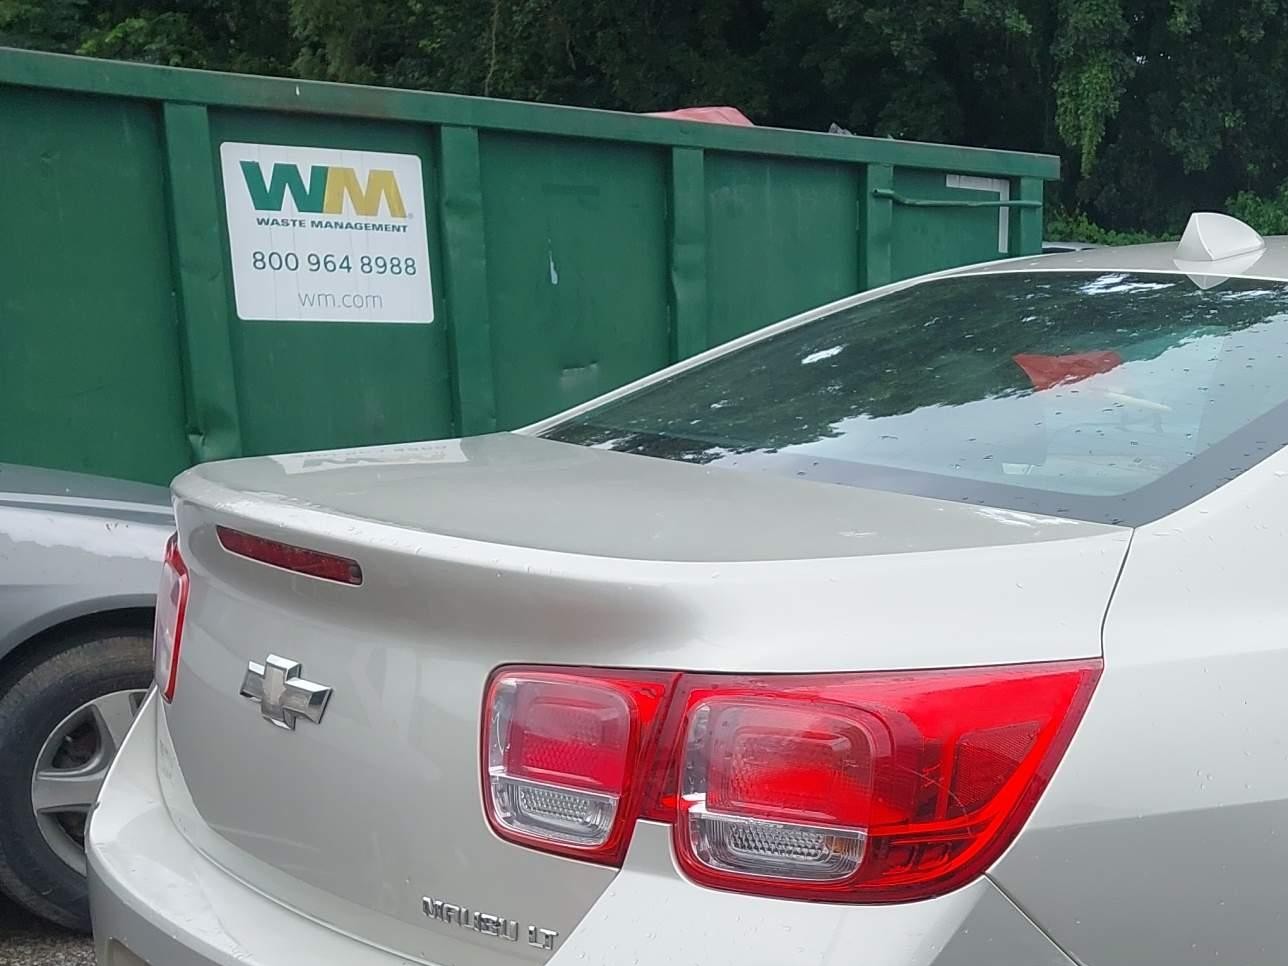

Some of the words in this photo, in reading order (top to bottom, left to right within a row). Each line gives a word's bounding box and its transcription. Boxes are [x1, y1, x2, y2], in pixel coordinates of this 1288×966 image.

[240, 160, 408, 218] WM
[256, 217, 306, 228] WASTE
[310, 220, 408, 233] MANAGEMENT
[252, 251, 299, 272] 800
[307, 253, 353, 273] 964
[360, 255, 417, 276] 8988
[298, 292, 383, 309] wm.com
[422, 896, 519, 942] MALIBU
[528, 925, 560, 951] LT
